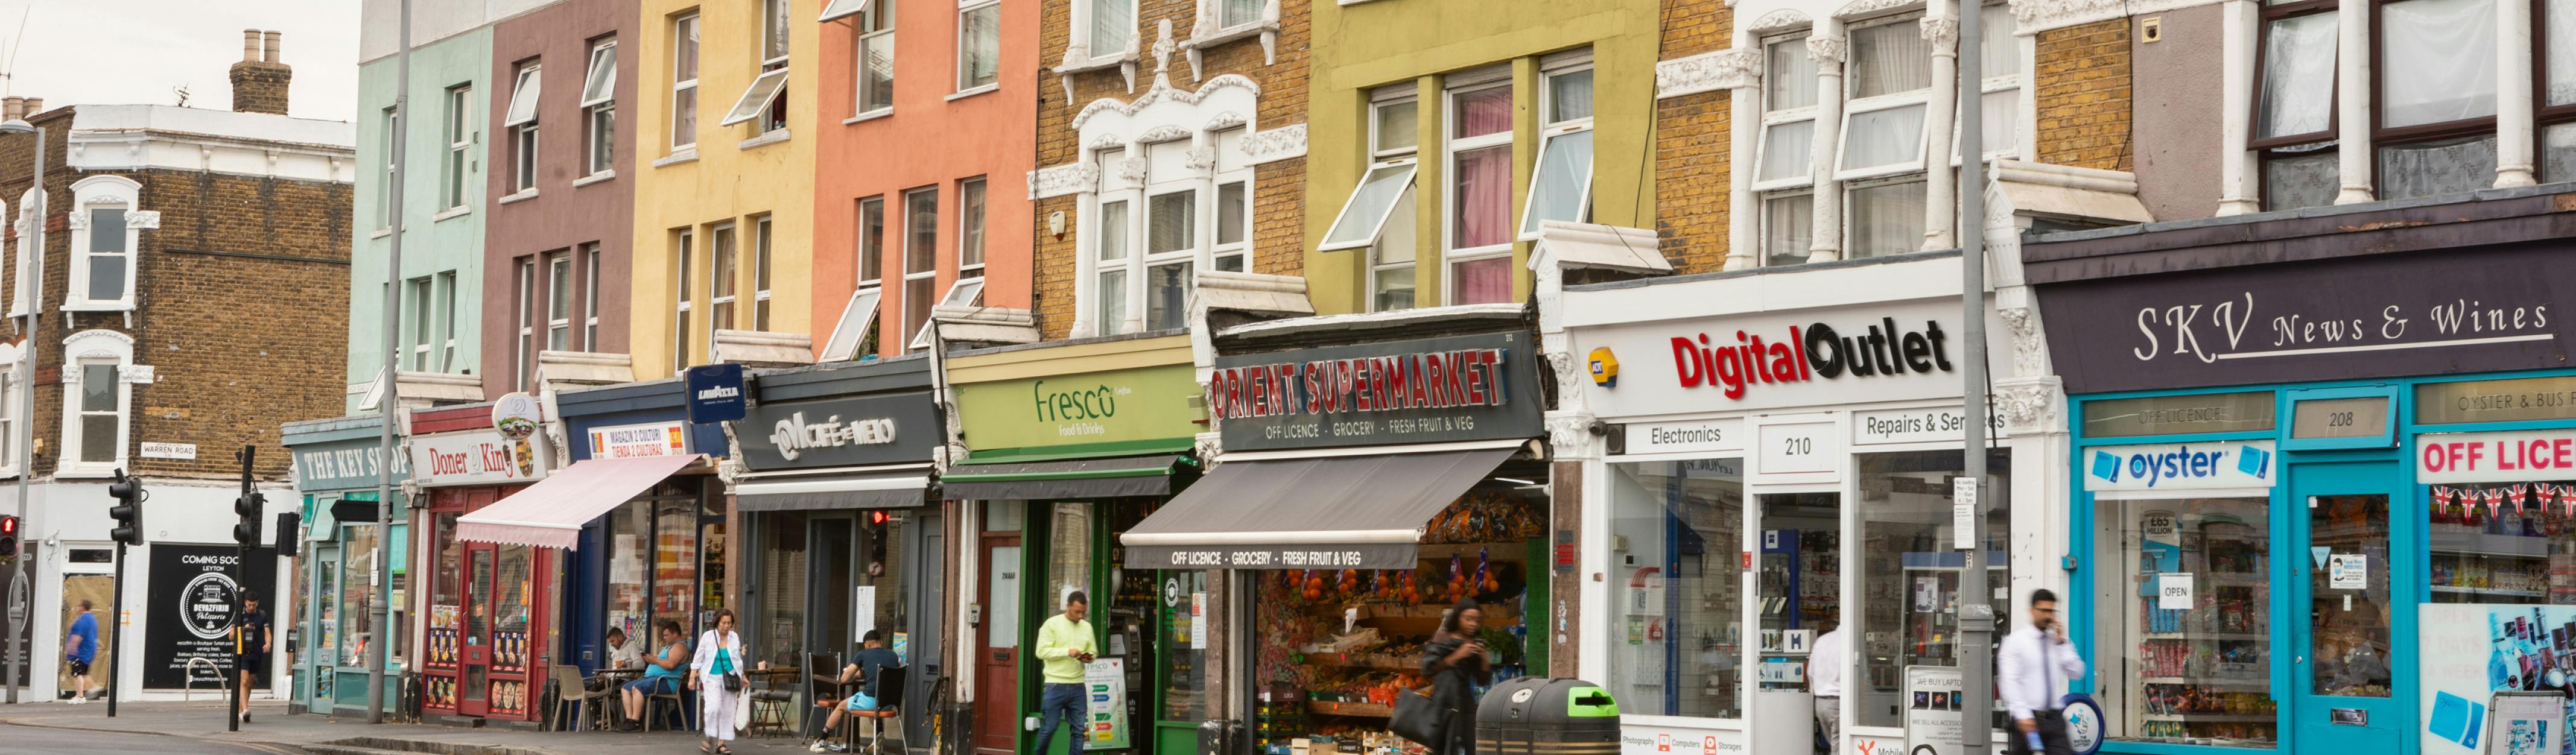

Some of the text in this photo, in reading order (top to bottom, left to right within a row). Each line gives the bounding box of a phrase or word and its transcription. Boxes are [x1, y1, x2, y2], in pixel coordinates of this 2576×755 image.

[2134, 292, 2546, 363] SKV News & Wines
[1212, 349, 1502, 420] ORIENT SUPERMARKET
[2458, 395, 2513, 411] OYSTER
[2520, 394, 2530, 408] &
[2537, 391, 2563, 407] BUS
[2138, 408, 2221, 424] OFF LICENCE
[2329, 412, 2353, 427] 208
[1083, 422, 1105, 435] Drinks
[1266, 425, 1281, 439] OFF
[1284, 423, 1319, 438] LICENCE
[1334, 420, 1375, 437] GROCERY
[1390, 418, 1416, 434] FRESH
[1419, 417, 1442, 432] FRUIT
[1445, 417, 1452, 431] &
[1455, 415, 1474, 431] VEG
[1867, 412, 2005, 438] Repairs & Seres
[610, 428, 661, 443] MAGAZIN 2 CULTURI
[1652, 426, 1721, 444] Electronics
[612, 445, 630, 458] TIENDA
[631, 444, 635, 457] 2
[636, 443, 663, 457] CULTURAS
[1786, 437, 1811, 456] 210
[2424, 438, 2575, 472] OFF LICE
[304, 452, 335, 480] THE
[335, 448, 365, 478] KEY
[429, 443, 513, 478] Doner King
[2129, 446, 2222, 487] oyster
[182, 555, 217, 564] COMING
[1172, 551, 1187, 565] OFF
[1188, 551, 1221, 565] LICENCE
[1232, 551, 1272, 565] GROCERY
[1283, 551, 1307, 565] FRESH
[1309, 551, 1332, 565] FRUIT
[1334, 551, 1340, 565] &
[1342, 551, 1361, 565] VEG
[2165, 587, 2187, 596] OPEN
[1623, 736, 1654, 747] Photography
[1672, 739, 1700, 748] Computers
[1719, 741, 1742, 751] Storages
